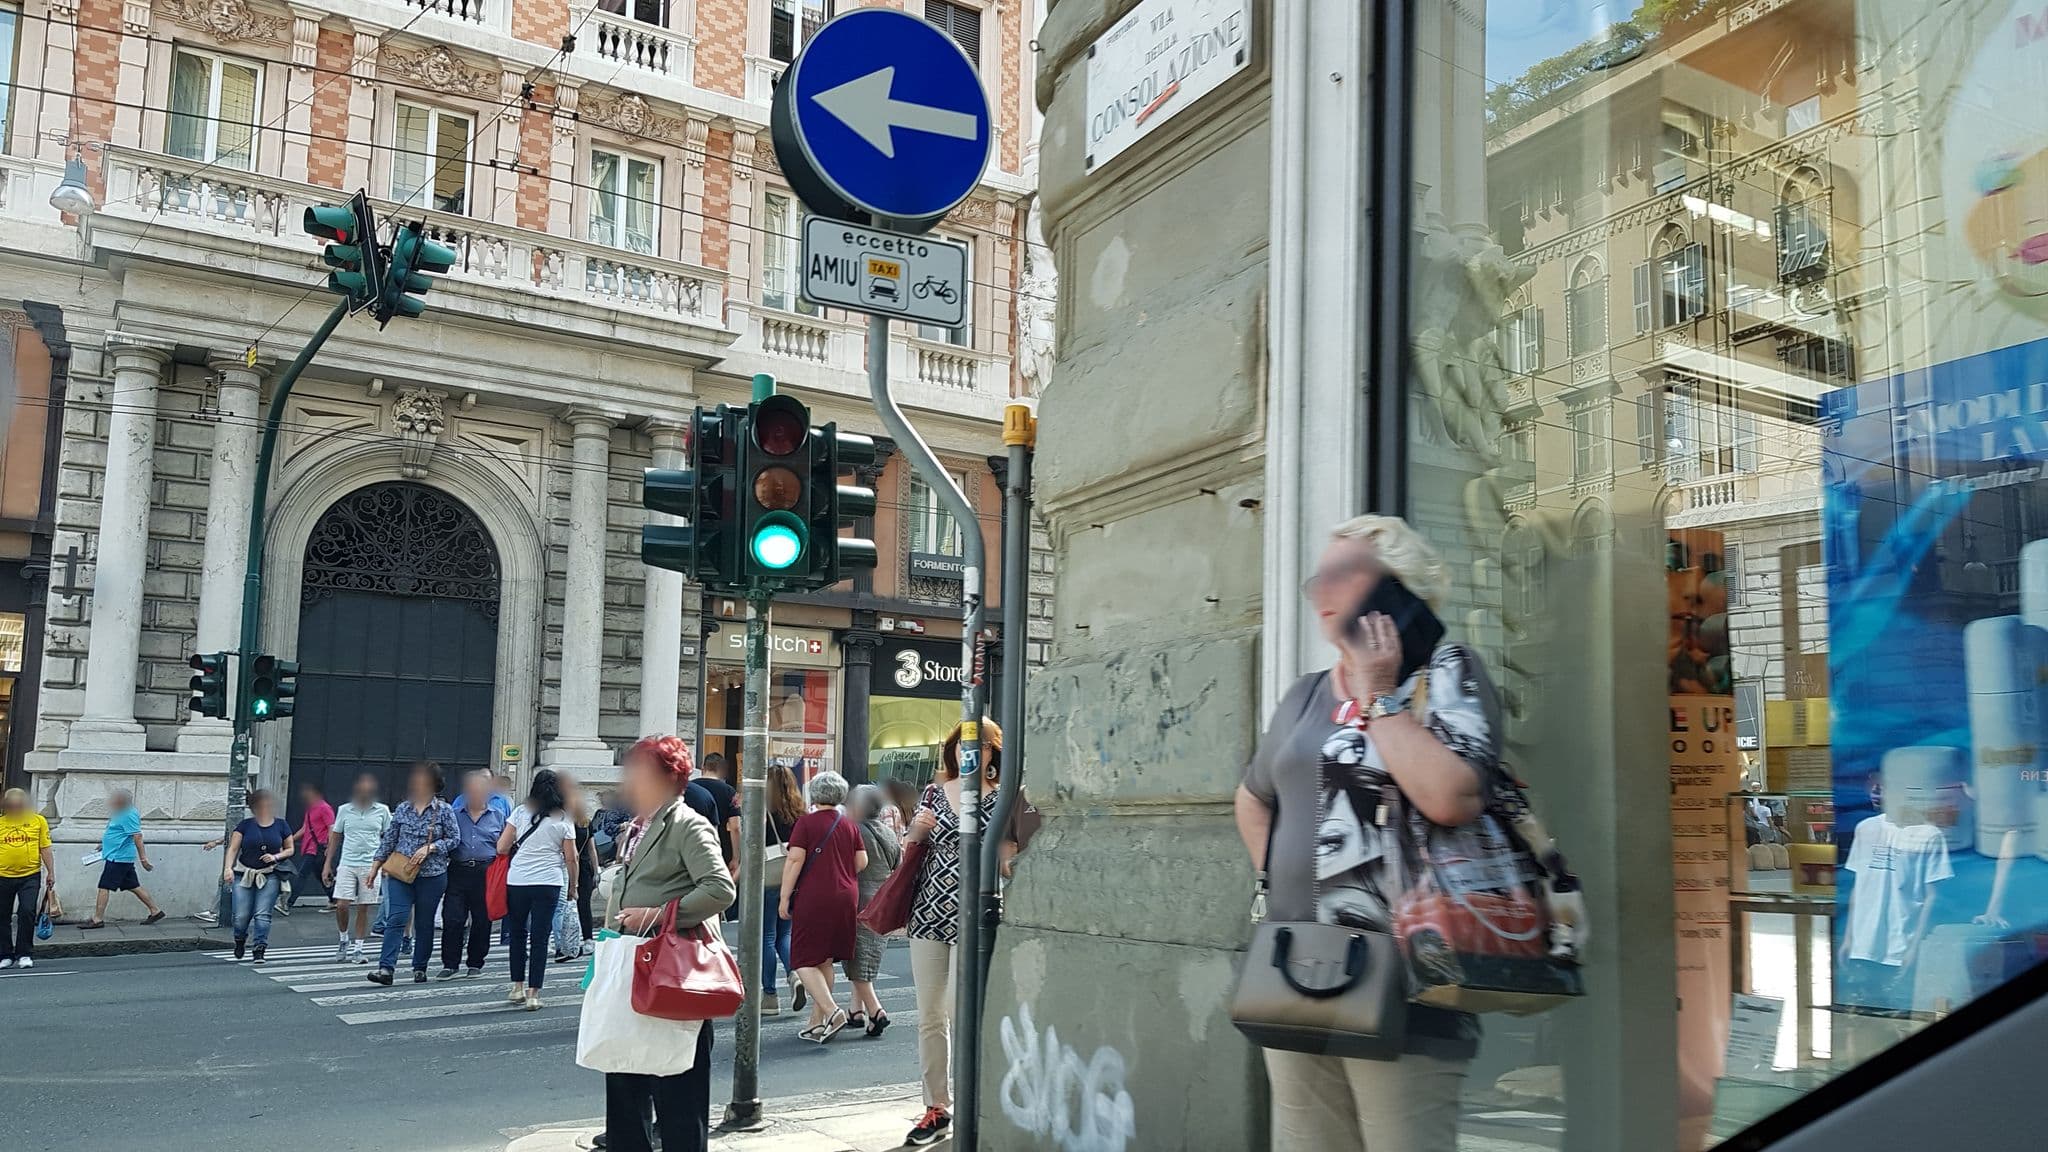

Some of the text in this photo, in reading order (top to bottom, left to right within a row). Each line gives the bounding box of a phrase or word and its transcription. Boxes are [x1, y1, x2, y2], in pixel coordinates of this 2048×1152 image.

[1150, 6, 1175, 34] VIA
[1144, 33, 1179, 66] DELLA
[1091, 10, 1243, 143] CONSOLAZIONE
[843, 231, 929, 258] eccetto
[810, 253, 858, 287] AMIU
[871, 262, 898, 276] TAXI
[895, 649, 923, 688] 3
